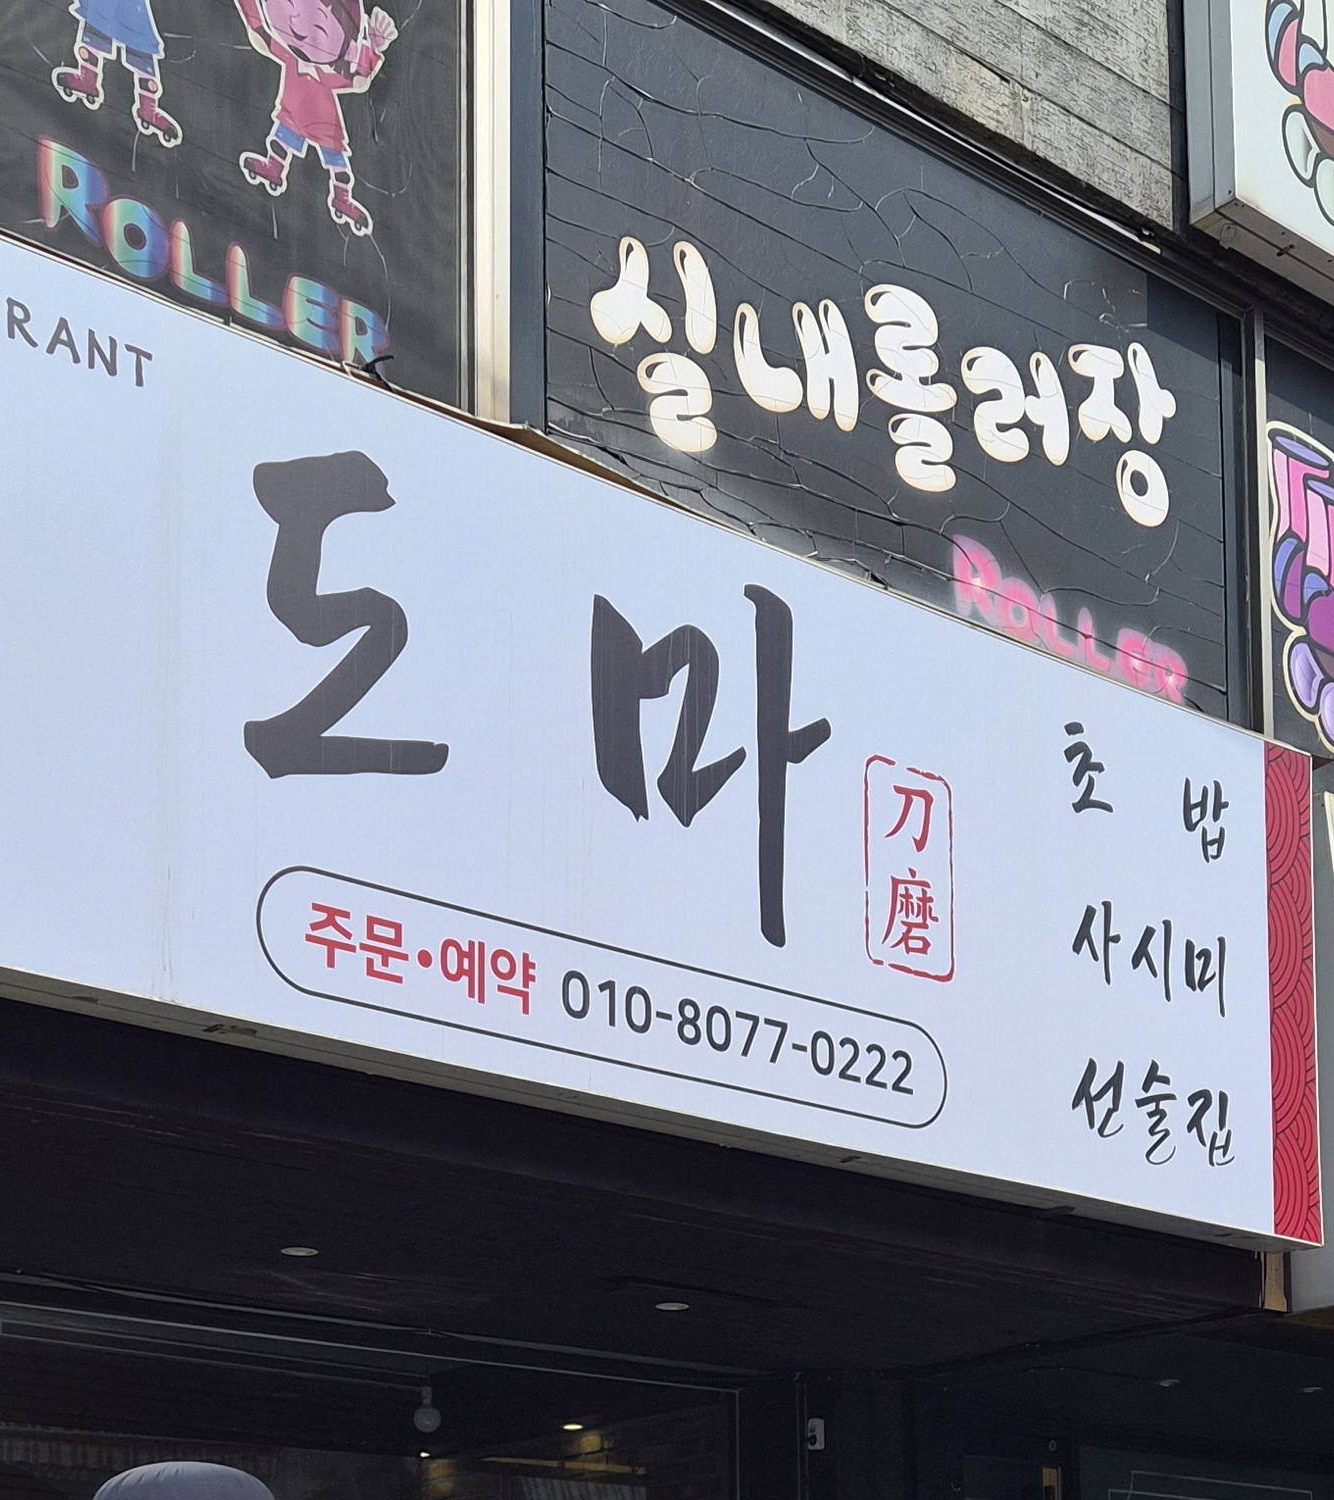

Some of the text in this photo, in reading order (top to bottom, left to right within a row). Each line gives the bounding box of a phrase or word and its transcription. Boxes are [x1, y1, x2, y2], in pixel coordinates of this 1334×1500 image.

[38, 136, 389, 367] ROLLER
[590, 236, 1176, 527] 실내롤러장
[953, 534, 1189, 705] ROLLER
[561, 969, 915, 1096] 010-8077-0222
[1071, 900, 1227, 1018] 사시미
[1071, 1057, 1235, 1167] 선술집
